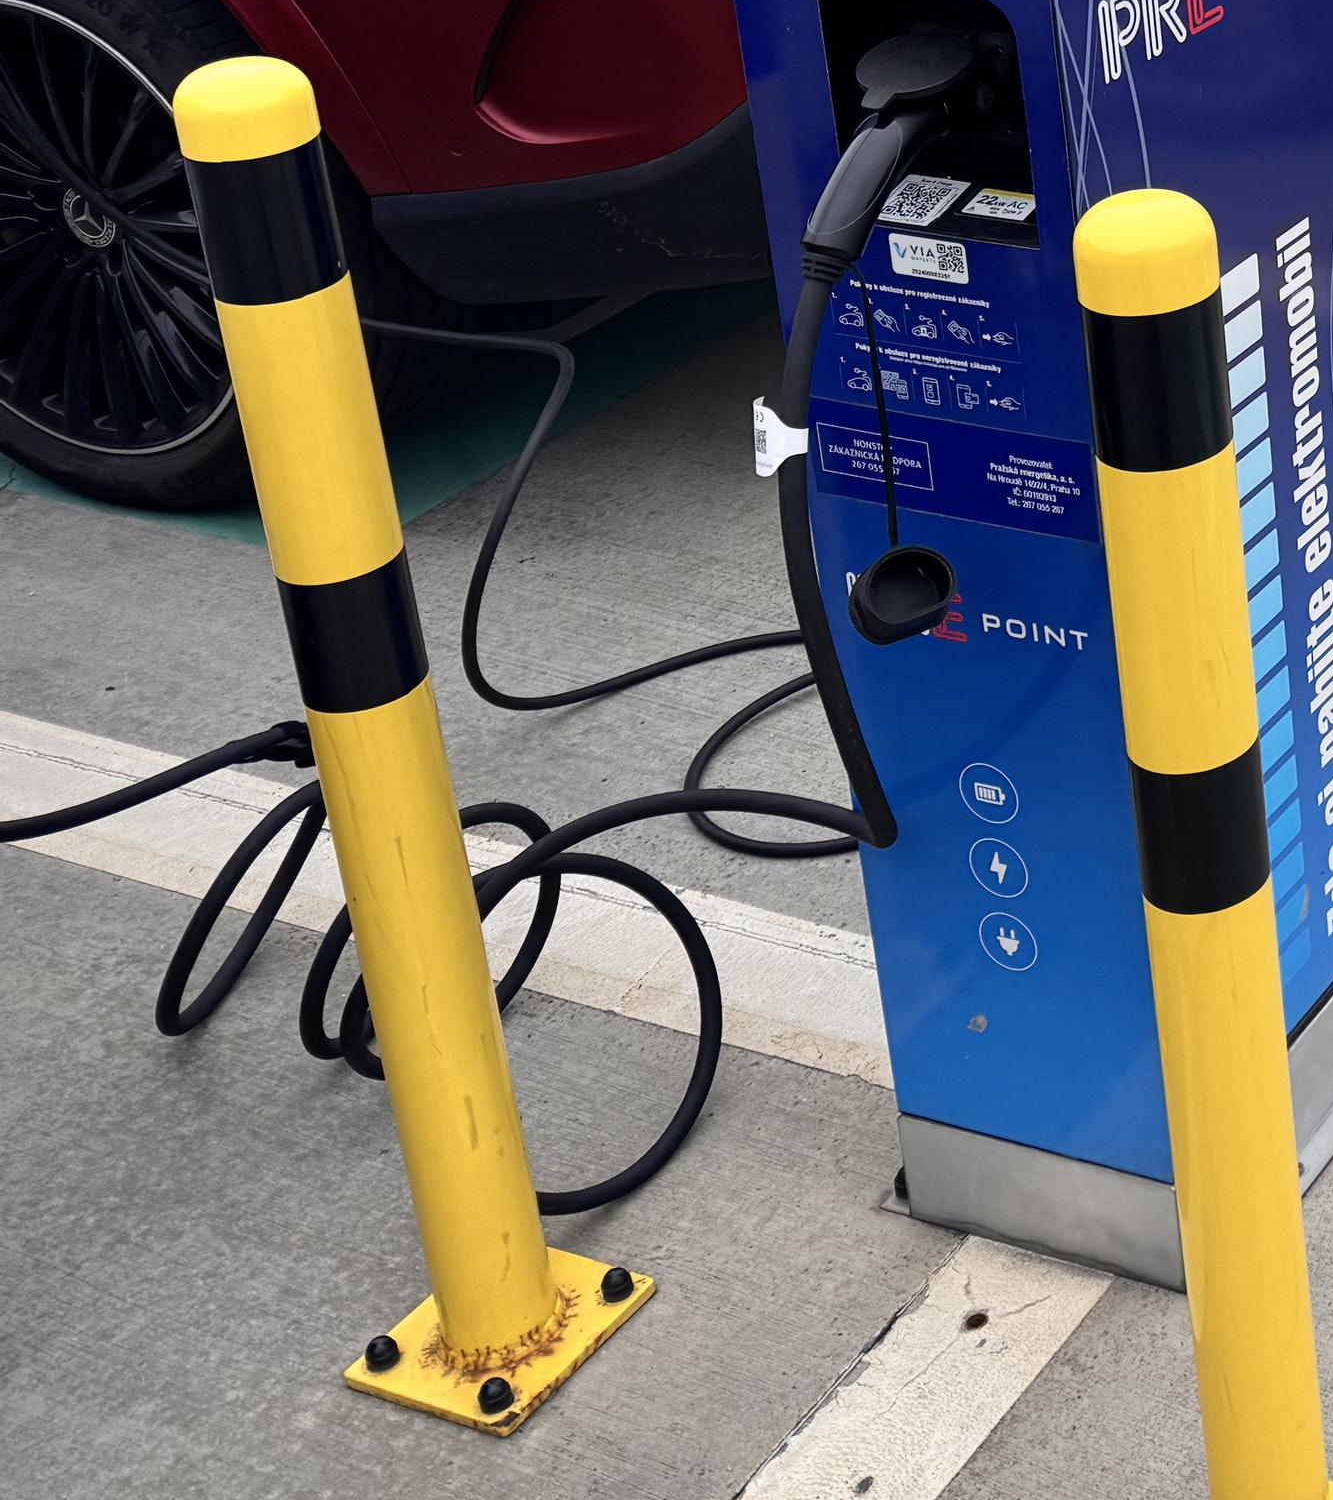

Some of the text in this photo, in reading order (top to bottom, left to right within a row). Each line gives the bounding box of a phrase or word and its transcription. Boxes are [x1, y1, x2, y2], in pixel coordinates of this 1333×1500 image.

[1006, 201, 1028, 210] AC
[910, 244, 935, 258] VIA
[904, 289, 916, 298] pro
[909, 352, 921, 361] pro
[1275, 216, 1333, 573] elektromobil
[853, 438, 893, 451] NONST
[828, 444, 880, 462] ZÁKAZNICKÁ
[851, 460, 866, 469] 267
[867, 463, 884, 473] 055
[990, 462, 1019, 475] Pražská
[986, 472, 997, 482] Na
[1050, 483, 1071, 495] Praha
[1072, 487, 1081, 496] 10
[1022, 499, 1035, 510] 267
[1036, 502, 1051, 512] 055
[982, 612, 1088, 651] POINT
